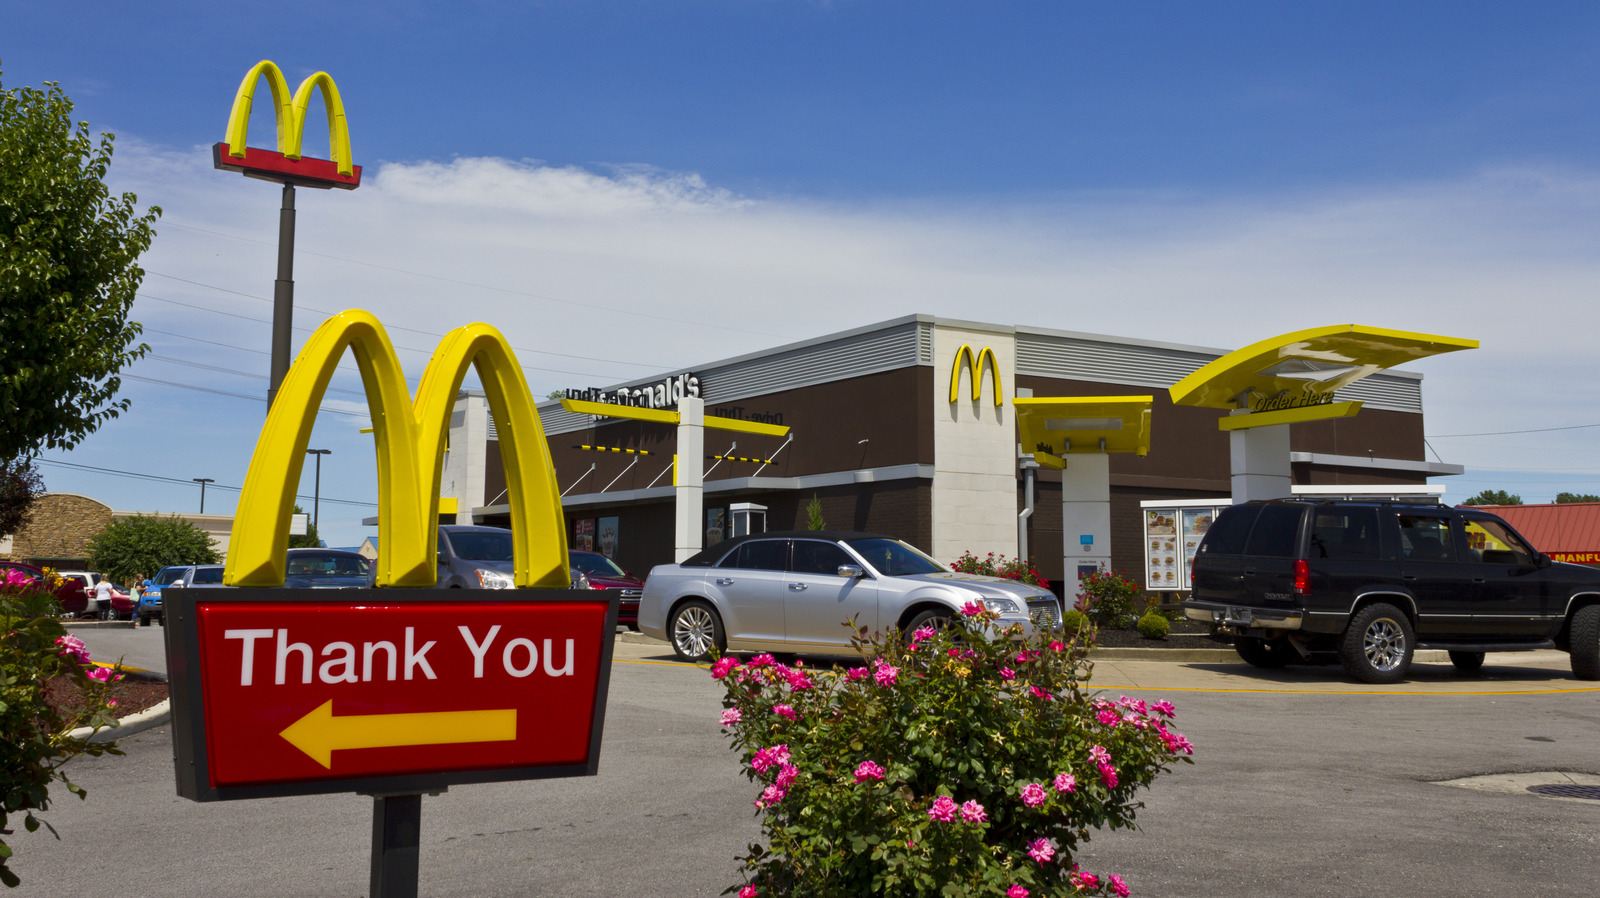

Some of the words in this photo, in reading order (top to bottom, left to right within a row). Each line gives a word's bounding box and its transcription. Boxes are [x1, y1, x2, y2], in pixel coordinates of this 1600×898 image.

[592, 373, 700, 421] Donald's
[1254, 395, 1296, 412] Order
[1299, 390, 1334, 406] Here
[224, 626, 438, 686] Thank
[457, 625, 575, 678] You
